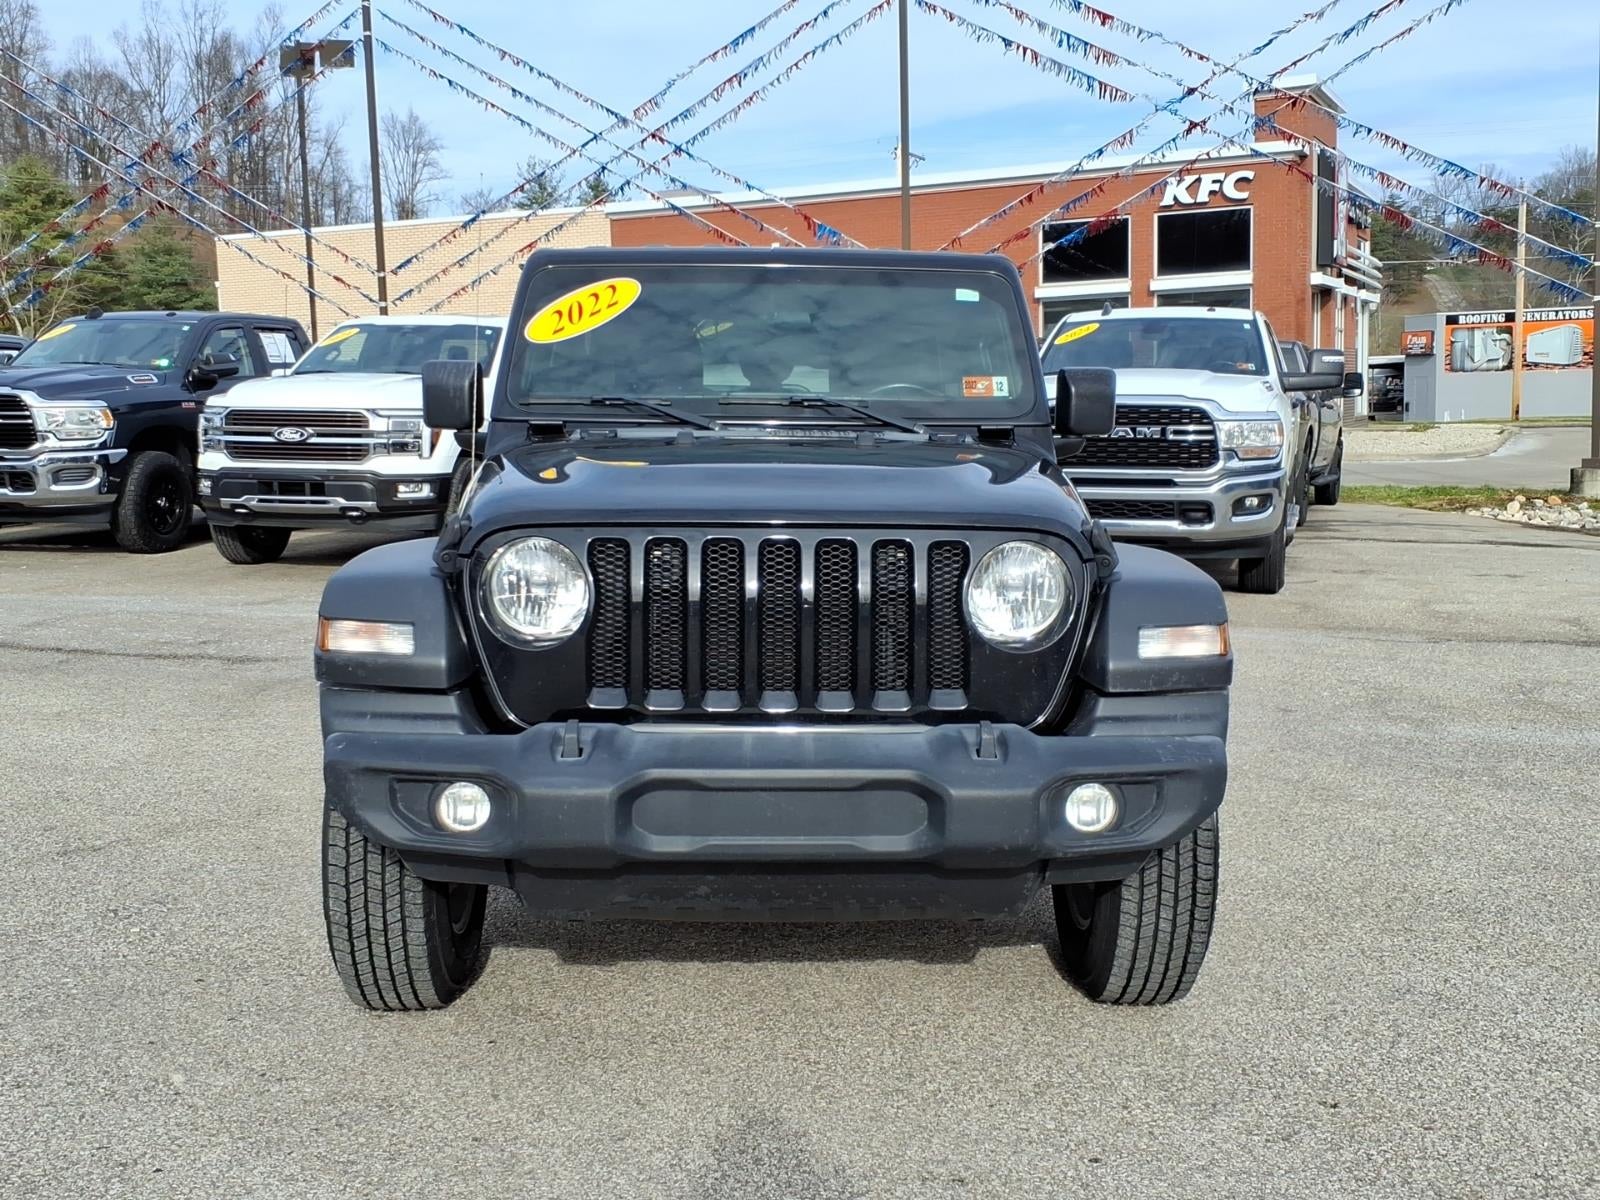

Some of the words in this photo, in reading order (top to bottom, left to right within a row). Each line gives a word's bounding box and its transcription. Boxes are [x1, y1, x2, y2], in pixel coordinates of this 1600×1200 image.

[1159, 170, 1256, 207] KFC
[551, 284, 619, 335] 2022
[1458, 313, 1506, 324] ROOFING
[996, 381, 1004, 391] 12
[280, 429, 302, 440] Ford
